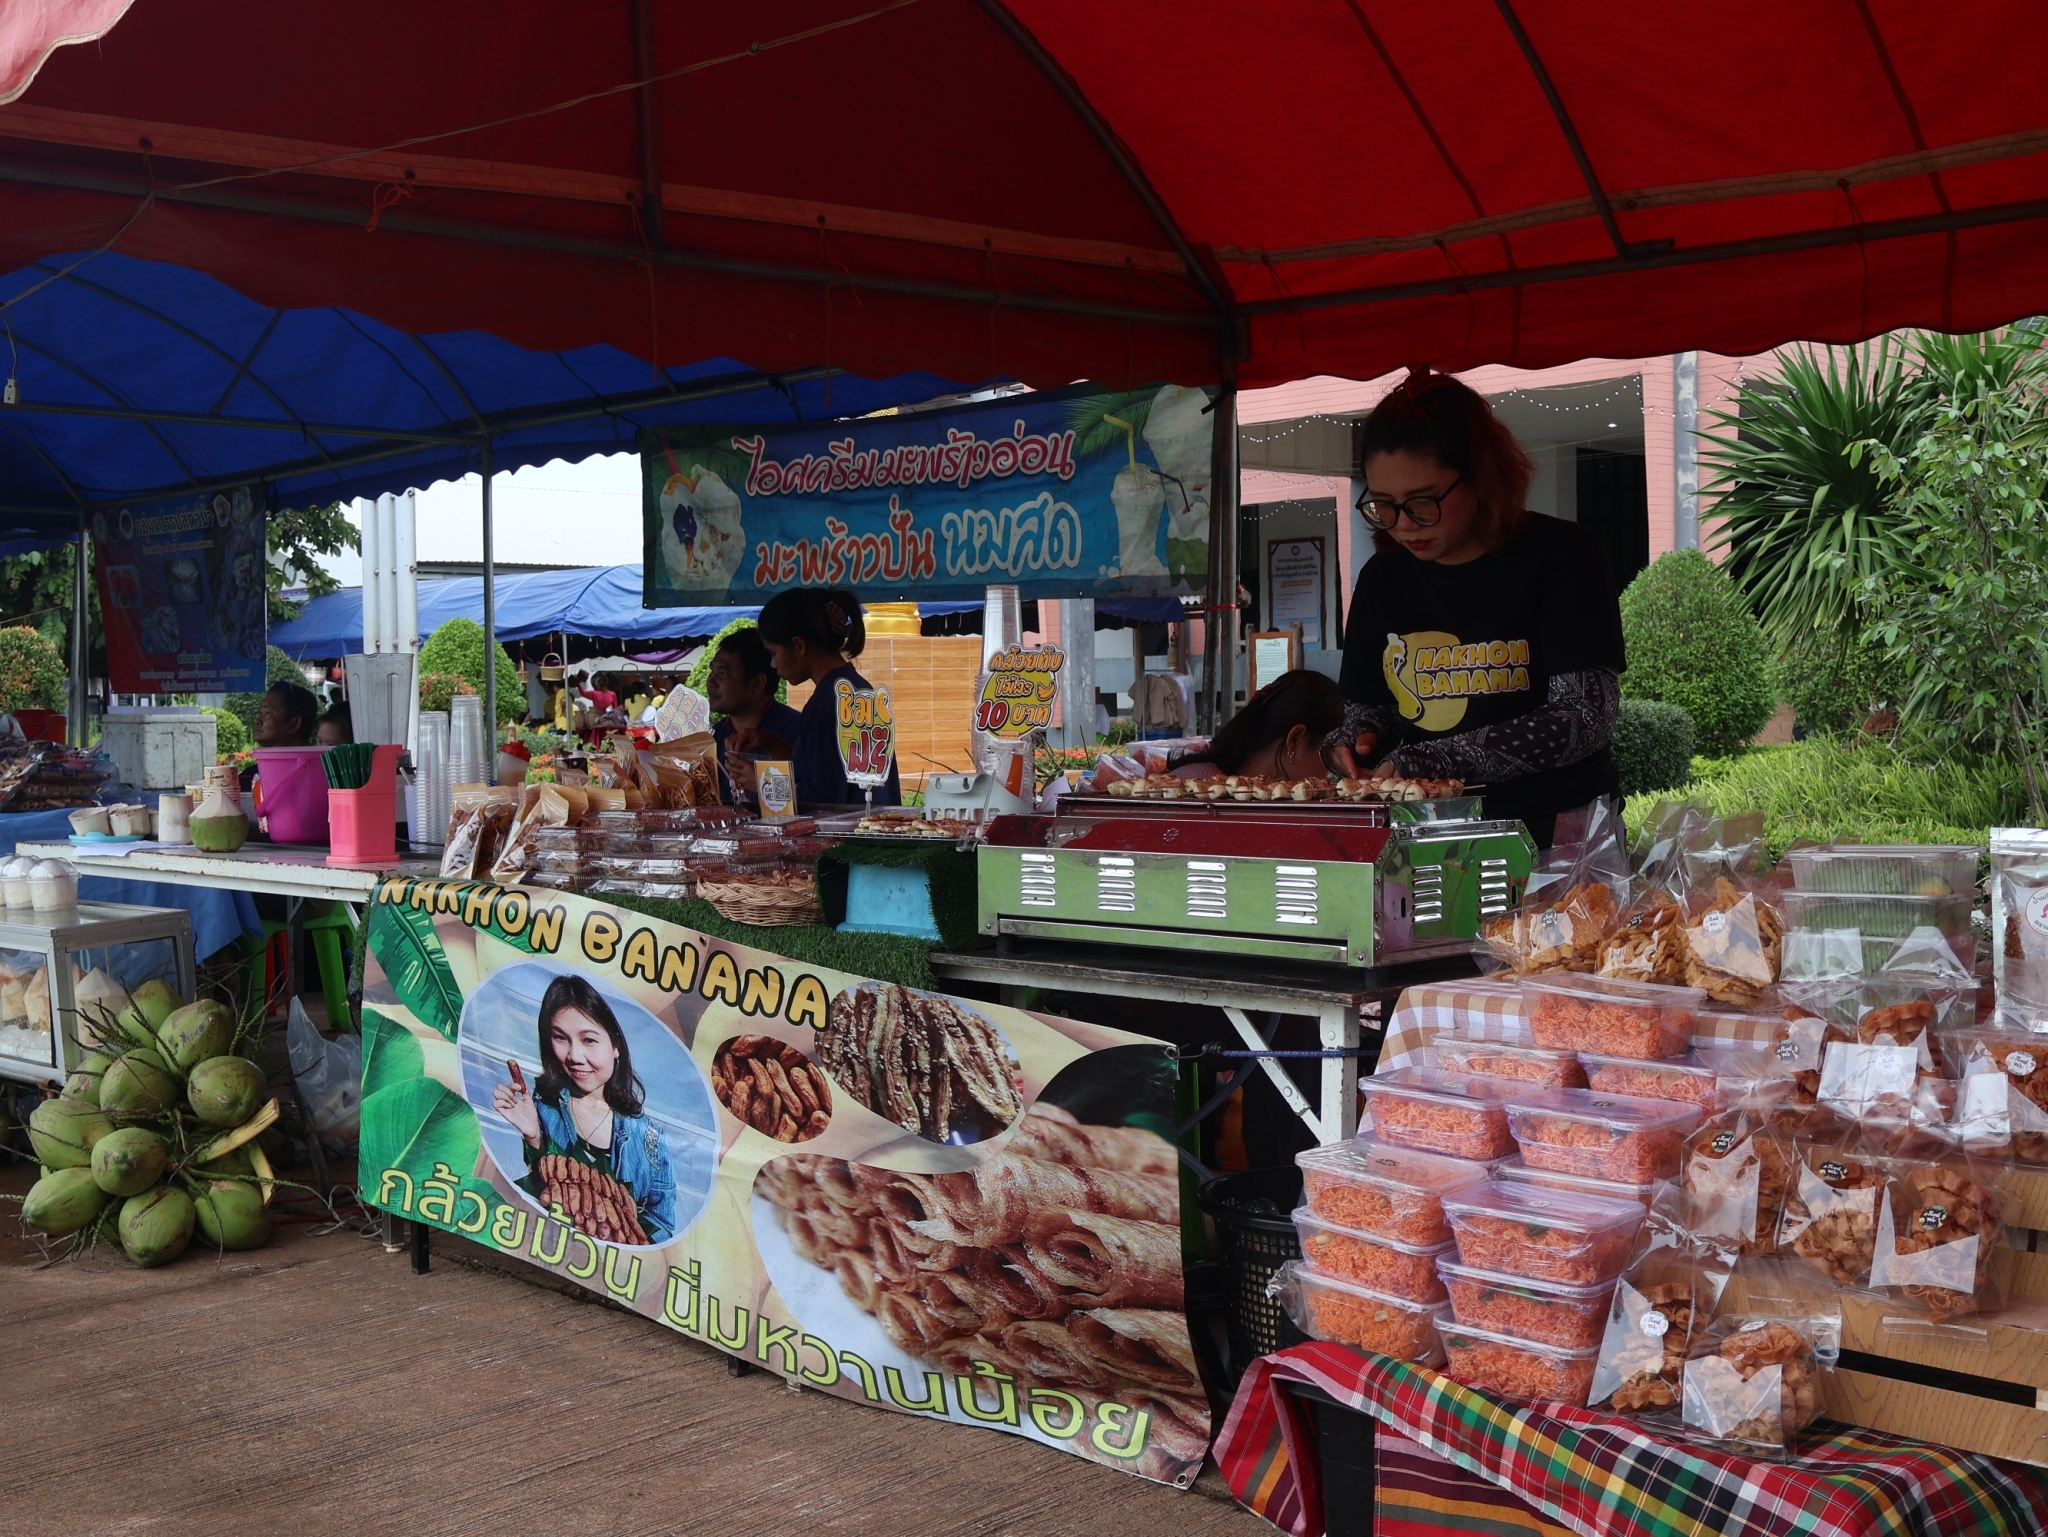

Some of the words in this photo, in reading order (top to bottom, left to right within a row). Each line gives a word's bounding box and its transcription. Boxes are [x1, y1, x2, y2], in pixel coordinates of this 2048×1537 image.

[731, 419, 1076, 496] ไอศครีมมะพร้าวอ่อน
[754, 493, 937, 587] มะพร้าวปั่น
[941, 491, 1082, 577] นมสด
[988, 645, 1064, 673] กล้วยทับ
[1416, 639, 1529, 672] NAKHON
[837, 681, 873, 728] ชิม
[995, 673, 1034, 698] ไม้ละ
[1416, 667, 1529, 698] BANANA
[976, 699, 1009, 731] 10
[1010, 703, 1051, 727] บาท
[846, 724, 890, 776] ฟรี
[377, 877, 567, 954] NAKHON
[581, 911, 831, 1032] BANANA
[379, 1162, 642, 1303] กล้วยม้วน
[663, 1257, 1154, 1461] นิ่มหวานน้อย
